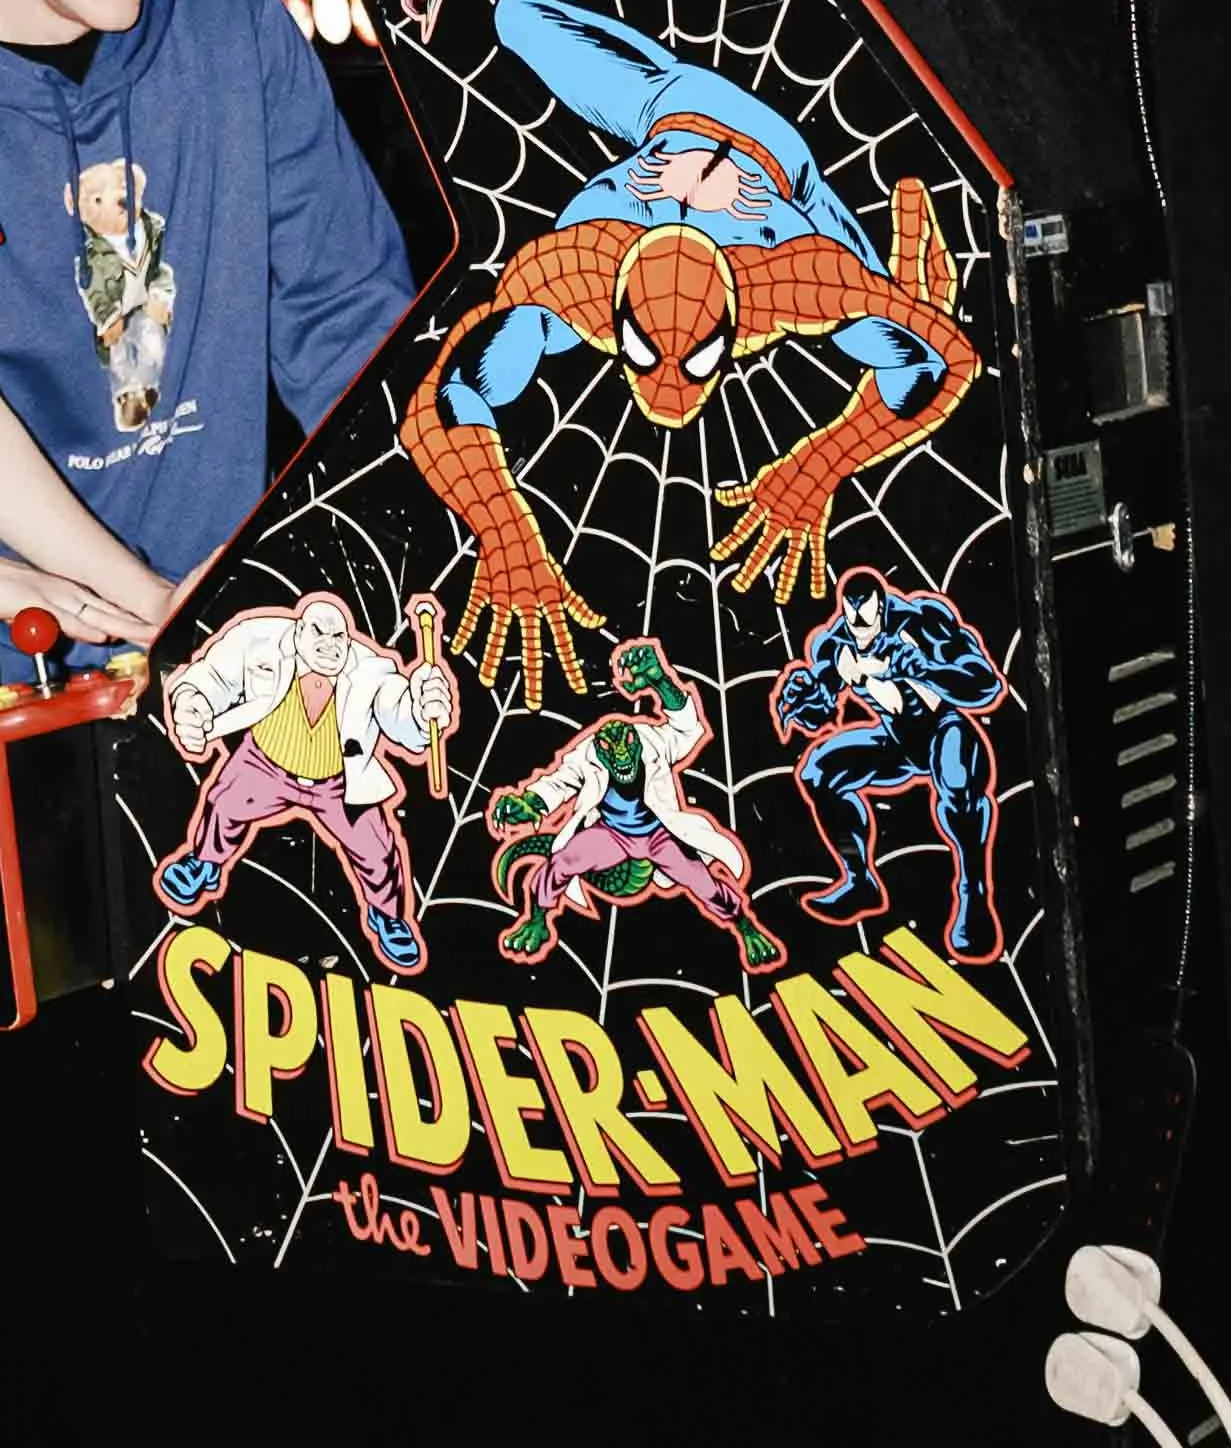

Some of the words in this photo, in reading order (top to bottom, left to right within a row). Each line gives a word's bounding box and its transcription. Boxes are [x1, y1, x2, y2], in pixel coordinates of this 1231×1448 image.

[67, 454, 105, 470] POLO
[143, 926, 1031, 1197] SPIDER-MAN
[333, 1173, 431, 1256] the
[429, 1183, 867, 1292] VIDEOGAME
